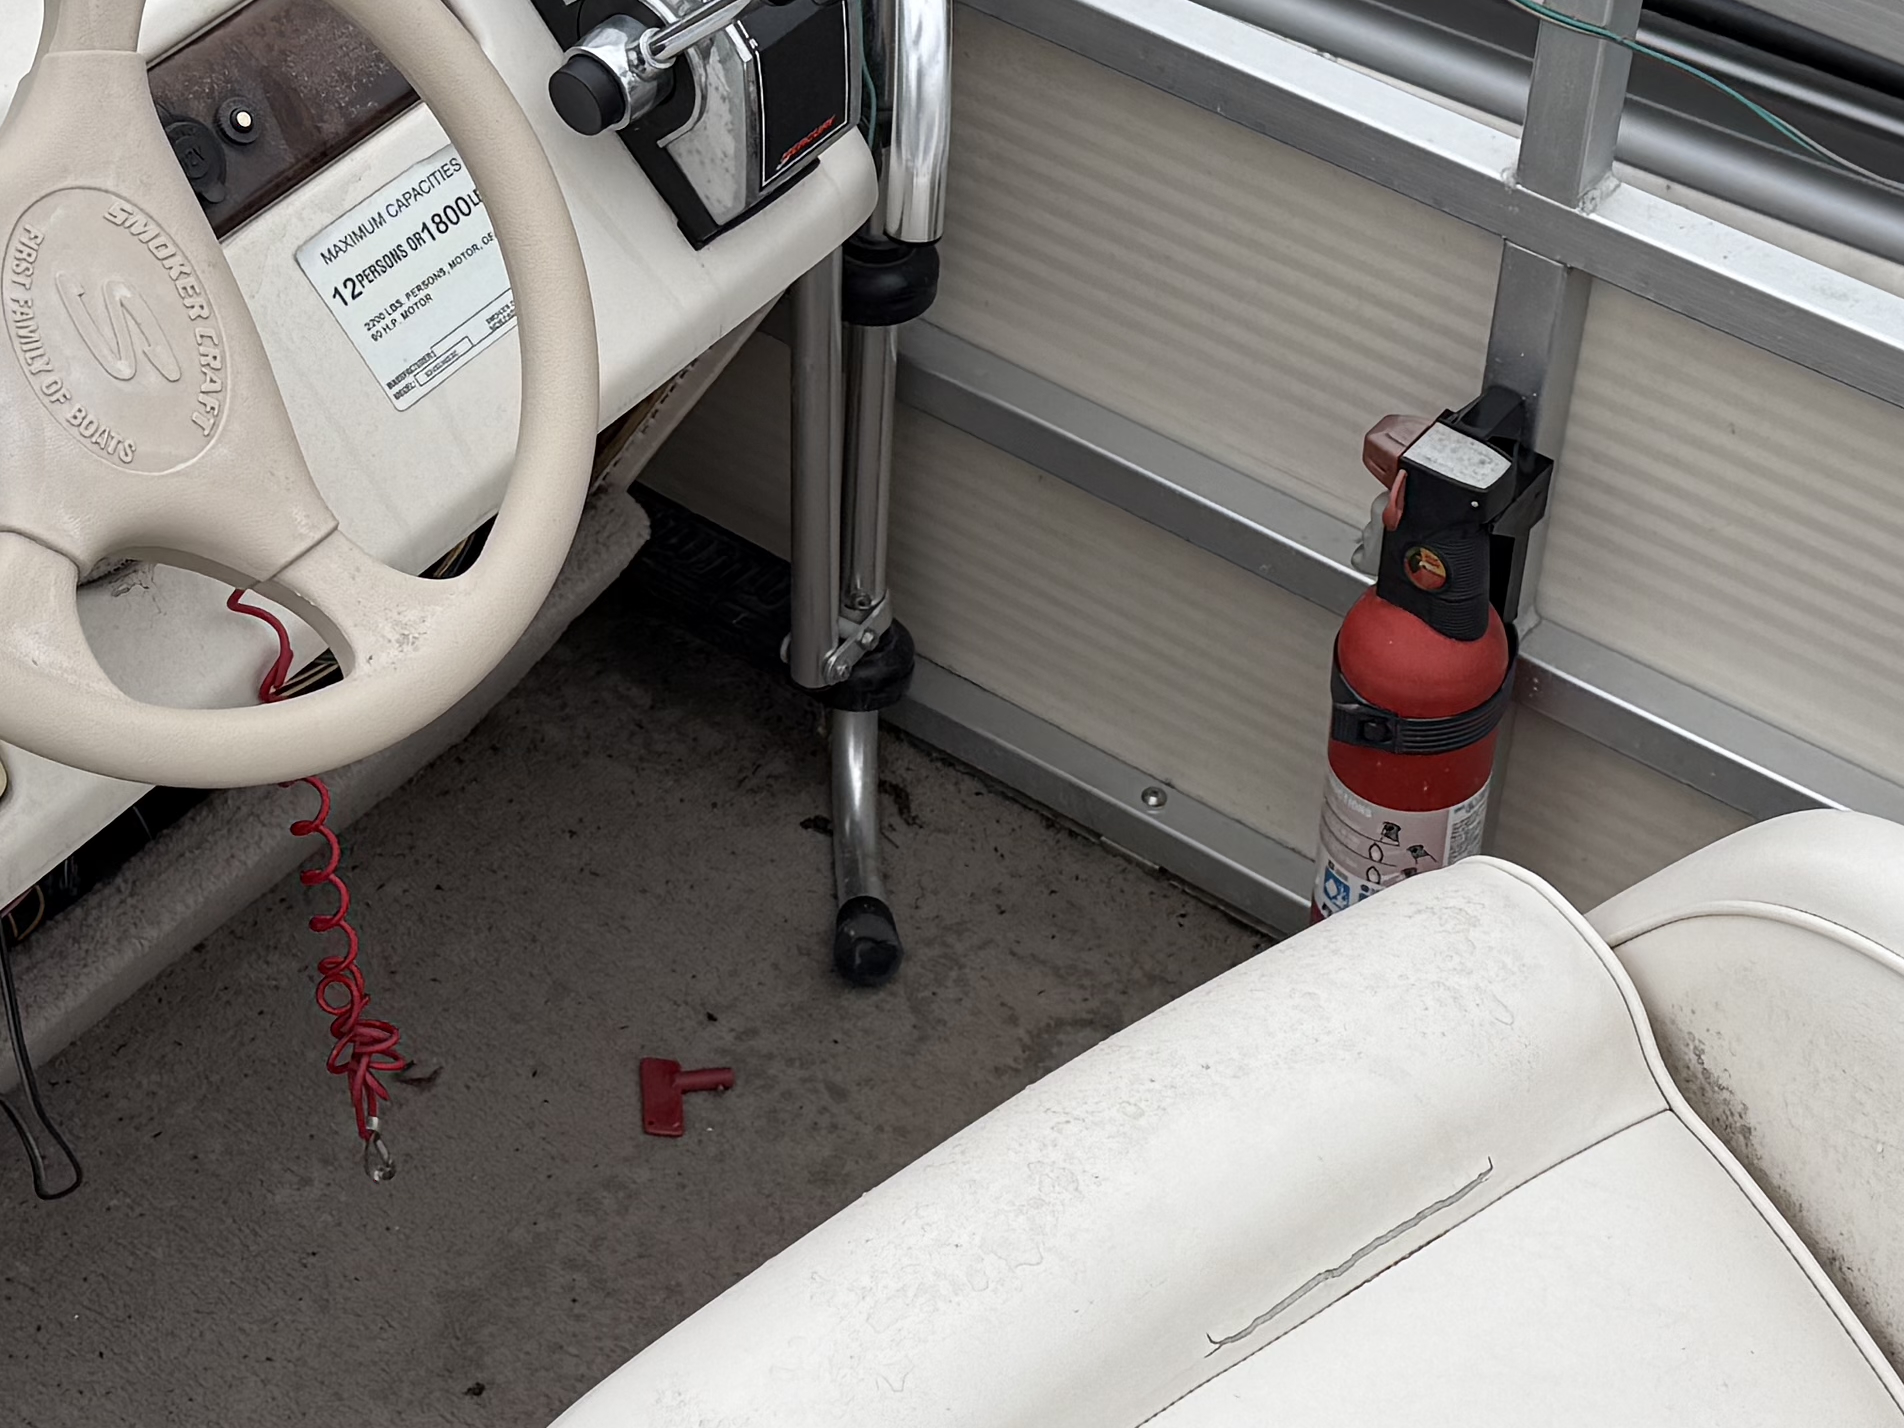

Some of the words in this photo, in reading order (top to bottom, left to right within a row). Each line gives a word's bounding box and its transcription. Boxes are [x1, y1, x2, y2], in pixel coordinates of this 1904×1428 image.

[320, 212, 387, 265] MAXIMUM
[385, 157, 462, 218] CAPACITIES
[11, 224, 45, 290] FIRST
[332, 277, 364, 307] 12
[355, 244, 409, 289] PERSONS
[405, 231, 427, 251] OR
[421, 196, 473, 241] 1800
[10, 296, 54, 376] FAMILY
[103, 201, 210, 320] SMOKER
[190, 327, 223, 437] CRAFT
[400, 293, 434, 322] MOTOR
[41, 375, 73, 405] OF
[66, 403, 137, 465] BOATS
